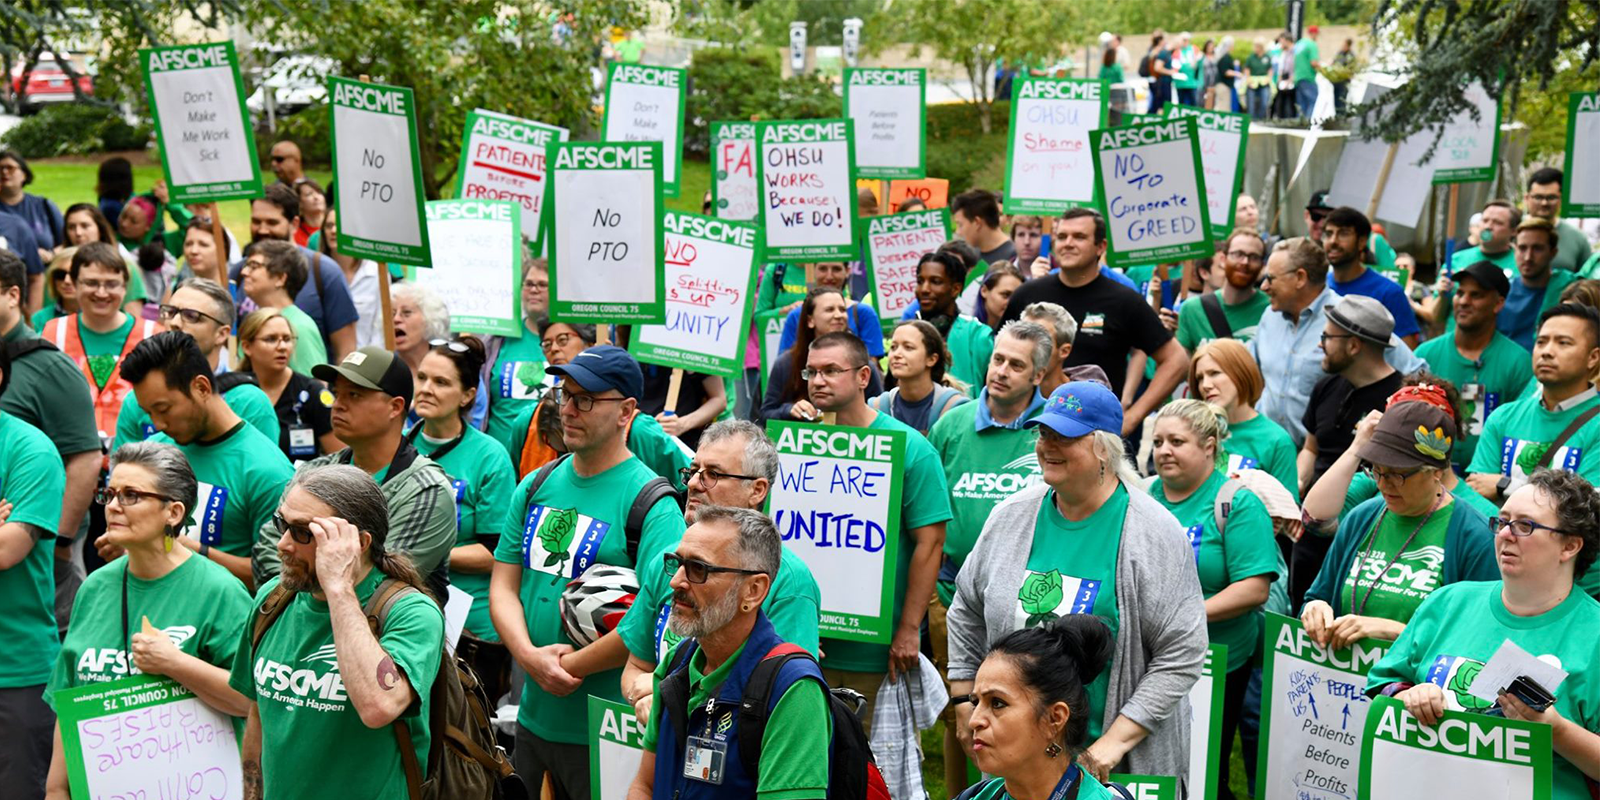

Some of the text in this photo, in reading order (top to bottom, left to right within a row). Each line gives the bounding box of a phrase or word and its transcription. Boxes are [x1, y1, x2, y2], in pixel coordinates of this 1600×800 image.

[149, 45, 229, 71] AFSCME
[612, 65, 680, 87] AFSCME
[849, 70, 920, 85] AFSCME
[183, 91, 213, 104] Don't
[334, 83, 406, 115] AFSCME
[1018, 81, 1102, 100] AFSCME
[188, 110, 217, 123] Make
[633, 118, 658, 129] Make
[1027, 105, 1079, 125] OHSU
[182, 128, 230, 143] Me Work
[471, 117, 553, 146] AFSCME
[763, 122, 846, 143] AFSCME
[1024, 132, 1083, 150] Shame
[1099, 120, 1189, 149] AFSCME
[200, 149, 219, 161] Sick
[362, 149, 385, 169] No
[555, 147, 653, 168] AFSCME
[768, 147, 823, 167] OHSU
[1114, 153, 1144, 178] NO
[766, 173, 824, 188] WORKS
[1128, 173, 1164, 190] TO
[360, 181, 393, 203] PTO
[905, 187, 932, 201] NO
[1111, 194, 1187, 218] Corporate
[593, 208, 622, 228] No
[781, 207, 843, 229] WE DO!
[868, 211, 944, 234] AFSCME
[664, 213, 756, 248] AFSCME
[1128, 216, 1196, 241] GREED
[874, 229, 944, 249] PATIENTS
[588, 242, 629, 261] PTO
[678, 274, 740, 305] Splitting
[880, 282, 916, 297] STAF
[571, 303, 639, 313] OREGON COUNCIL 75
[690, 293, 716, 308] up
[665, 309, 730, 342] UNITY
[653, 347, 680, 357] OREGON
[682, 353, 709, 364] COUNCIL
[776, 427, 893, 461] AFSCME
[779, 460, 885, 497] WE ARE
[983, 491, 1010, 499] Americ
[208, 496, 221, 534] 328
[522, 507, 538, 560] AFSCM
[775, 509, 886, 552] UNITED
[579, 530, 598, 569] 328
[1404, 588, 1418, 597] For
[1419, 592, 1431, 600] Yo
[820, 614, 859, 627] OUNCIL 75
[1275, 623, 1391, 673] AFSCM
[103, 699, 118, 711] 75
[120, 688, 168, 707] COUNCIL
[306, 698, 345, 712] Happen
[1302, 719, 1356, 746] Patients
[1375, 704, 1531, 762] AFSCME
[1305, 744, 1350, 769] Before
[1304, 769, 1348, 793] Profits
